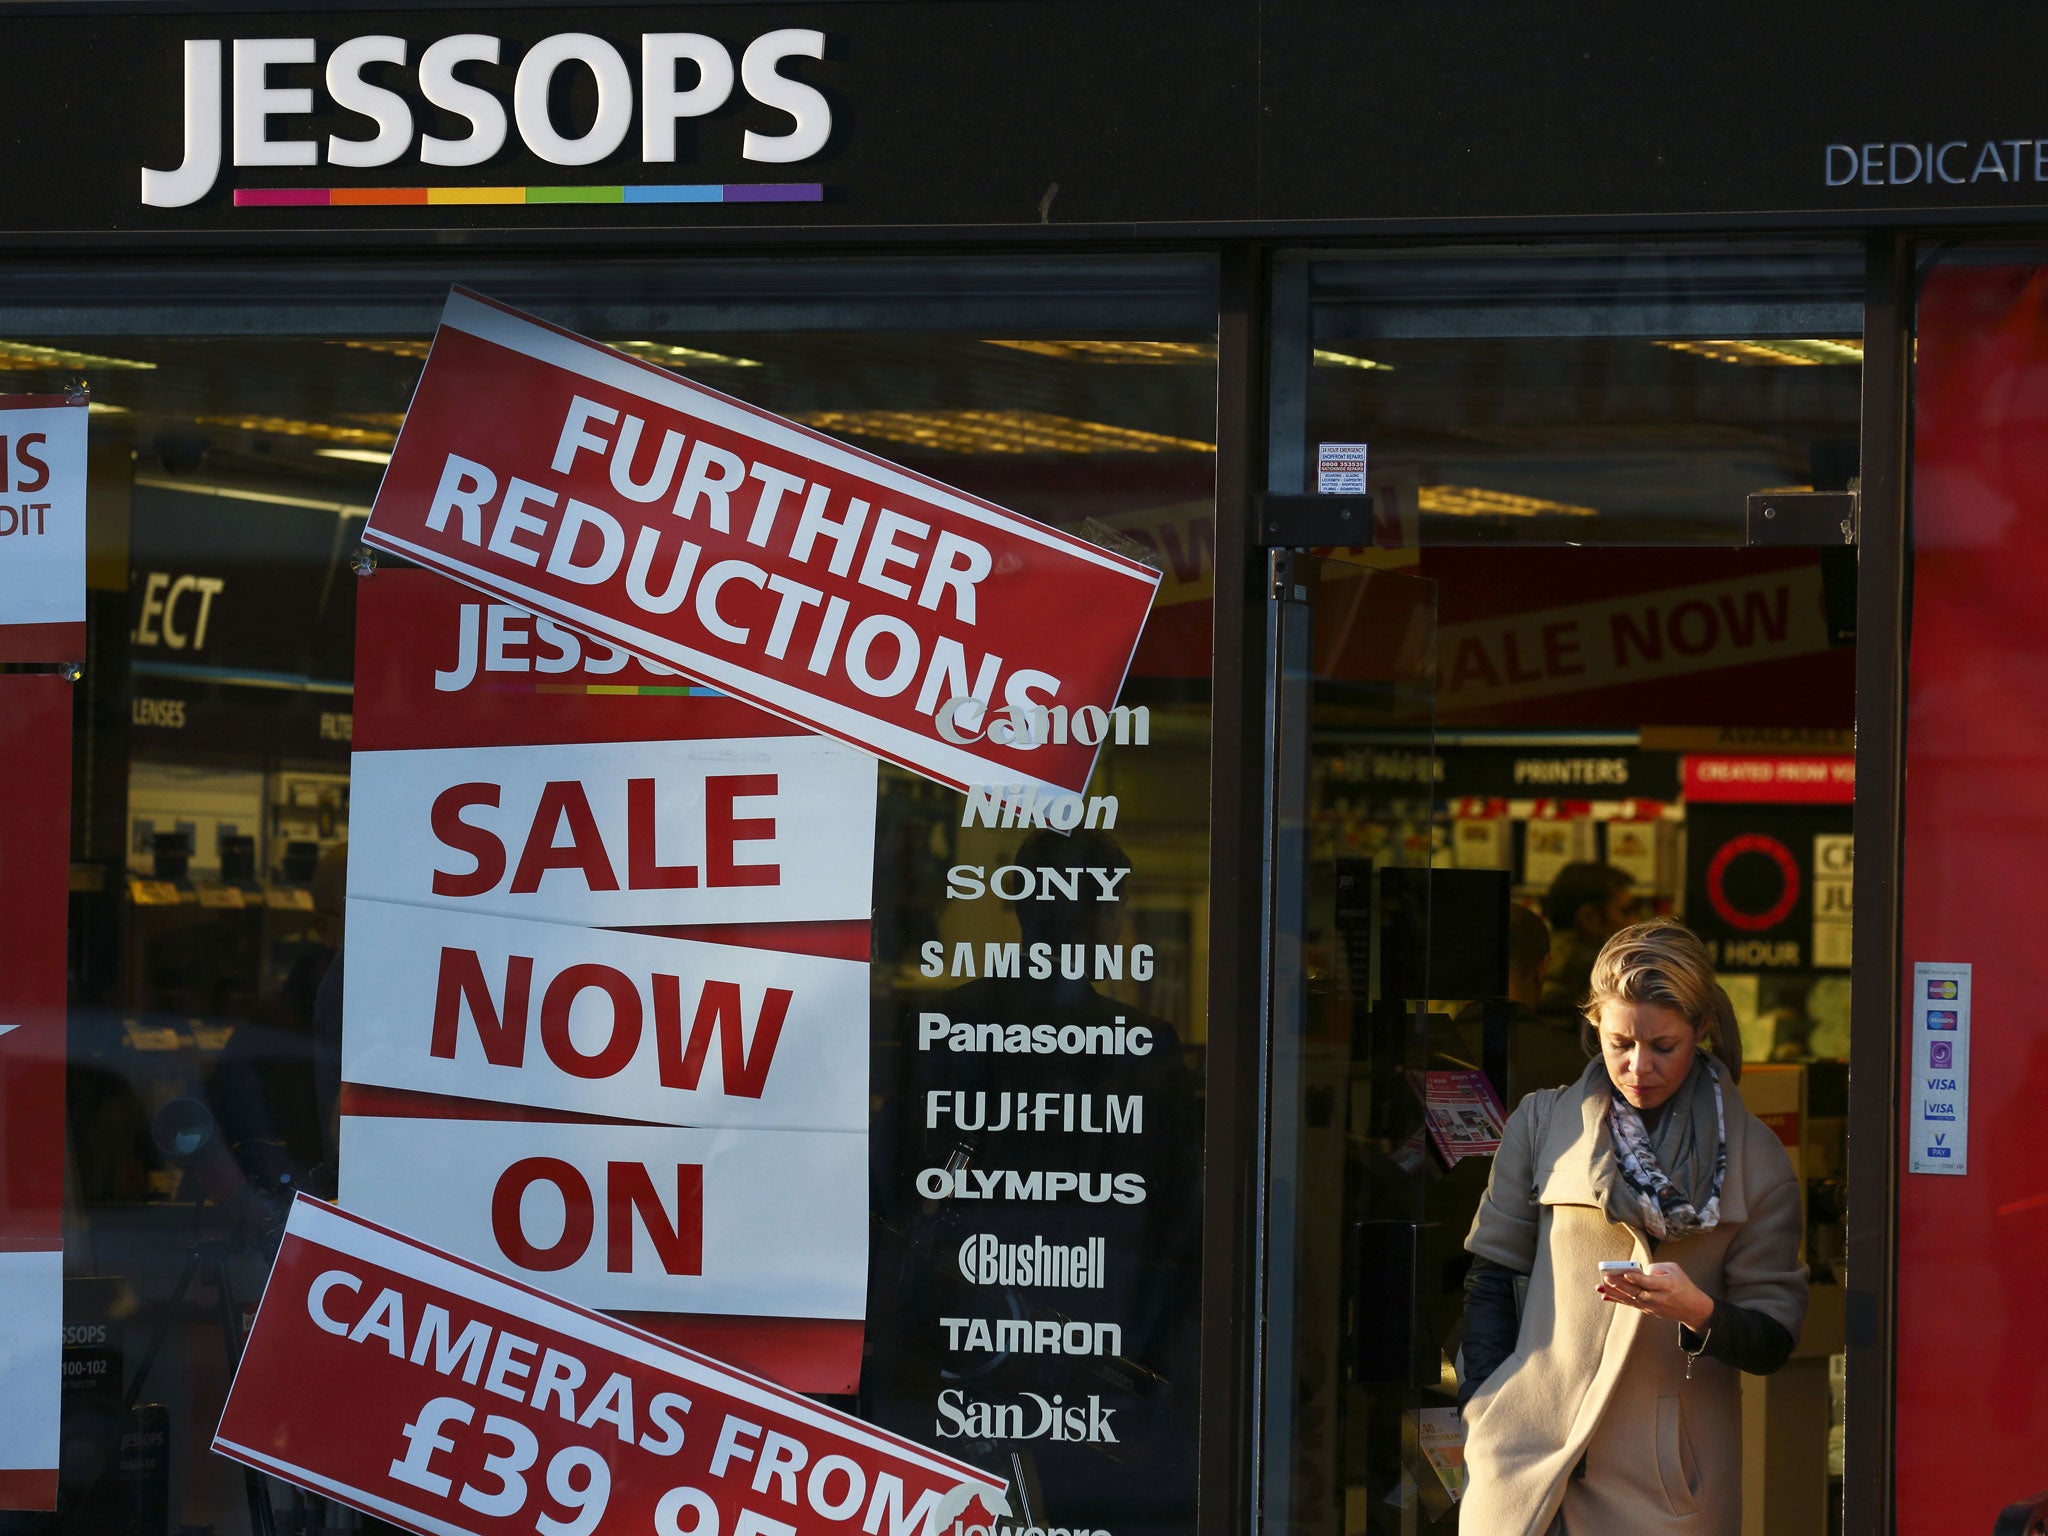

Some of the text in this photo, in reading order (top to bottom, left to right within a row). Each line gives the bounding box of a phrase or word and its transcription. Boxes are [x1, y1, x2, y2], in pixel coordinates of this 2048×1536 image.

[141, 28, 833, 208] JESSOPS
[1825, 138, 2048, 187] DEDICATE
[551, 394, 994, 625] FURTHER
[131, 572, 224, 650] ECT
[425, 452, 1062, 751] REDUCTIONS
[1437, 585, 1791, 694] ALE NOW
[132, 699, 186, 729] LENSES
[935, 696, 1150, 746] Canon
[1514, 758, 1629, 785] PRINTERS
[1697, 761, 1775, 783] CREATED
[1776, 762, 1829, 783] FROM
[961, 783, 1119, 830] Nikon
[430, 773, 781, 898] SALE
[946, 864, 1131, 901] SONY
[920, 940, 1154, 980] SAMSUNG
[1724, 940, 1799, 967] HOUR
[430, 946, 794, 1100] NOW
[918, 1012, 1153, 1056] Panasonic
[1926, 1078, 1957, 1091] VISA
[926, 1090, 1143, 1134] FUJIFILM
[1928, 1103, 1954, 1114] VISA
[1932, 1148, 1946, 1156] PAY
[916, 1167, 1147, 1205] OLYMPUS
[491, 1156, 704, 1277] ON
[978, 1233, 1105, 1289] Bushnell
[939, 1317, 1122, 1357] TAMRON
[307, 1269, 945, 1536] CAMERAS FROM
[936, 1389, 1120, 1443] SanDisk
